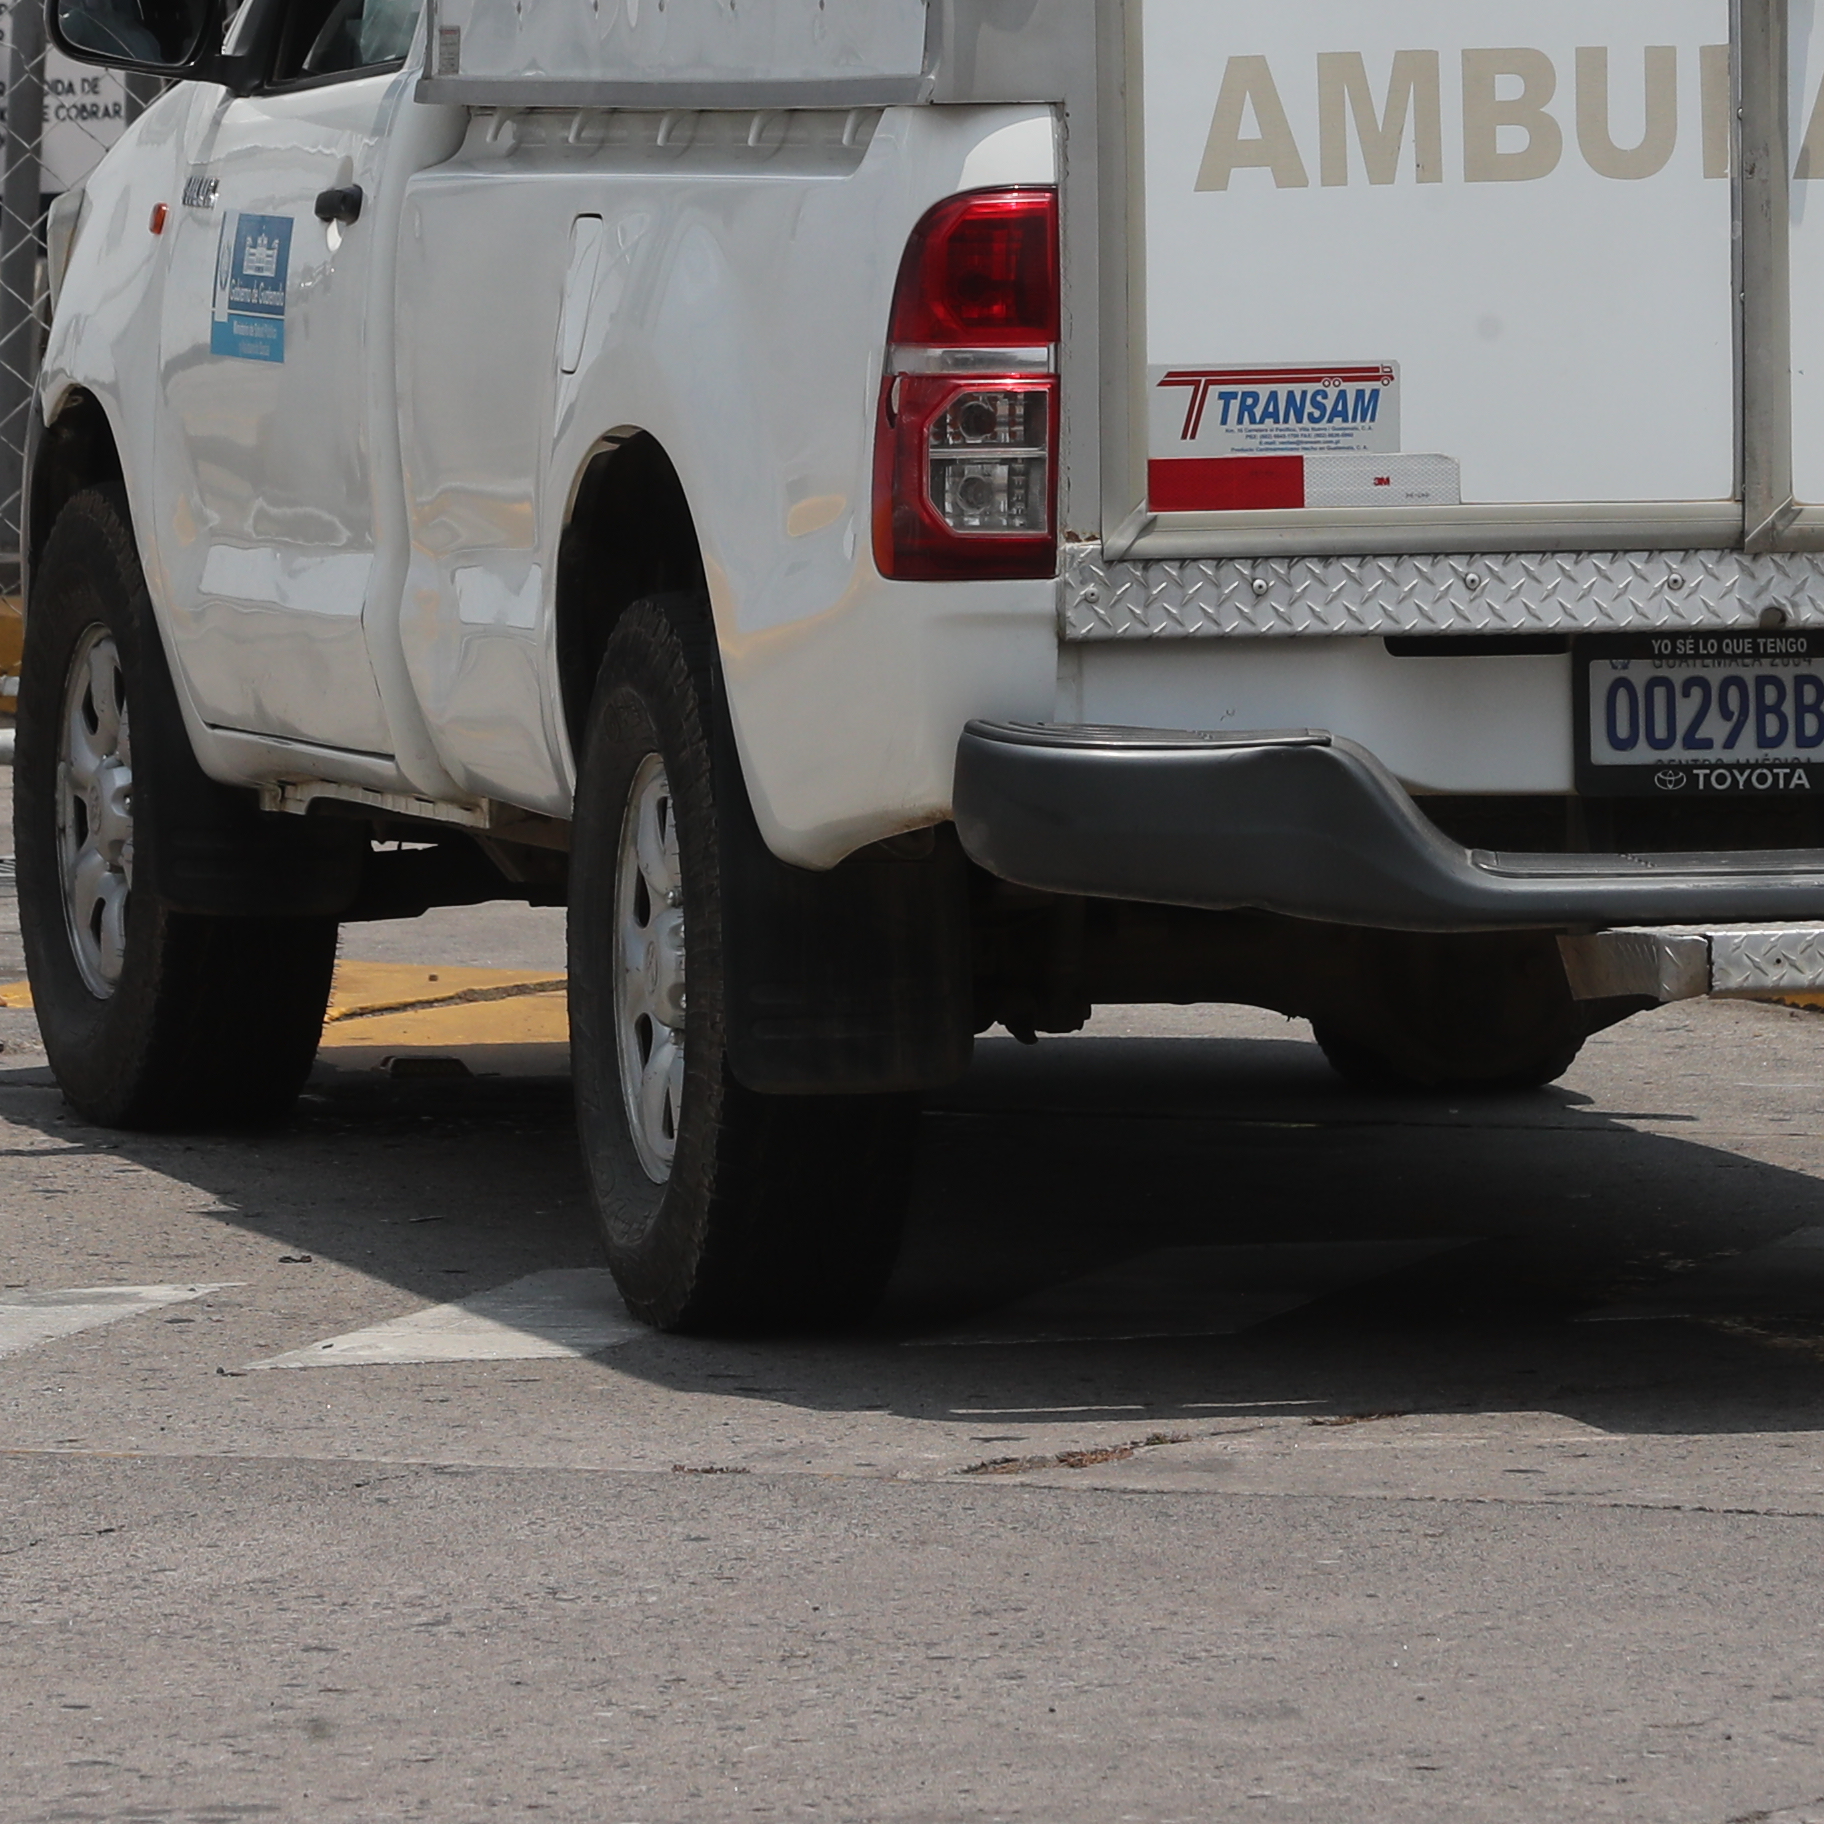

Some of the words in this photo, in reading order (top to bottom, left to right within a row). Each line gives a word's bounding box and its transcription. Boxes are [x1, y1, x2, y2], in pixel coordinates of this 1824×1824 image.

[1216, 388, 1381, 426] TRANSAM
[1373, 476, 1391, 486] 3M
[1651, 639, 1672, 654] YO
[1676, 635, 1695, 654] SÉ
[1698, 639, 1718, 654] LO
[1722, 638, 1754, 655] QUE
[1756, 637, 1808, 654] TENGO
[1692, 767, 1811, 790] TOYOTA
